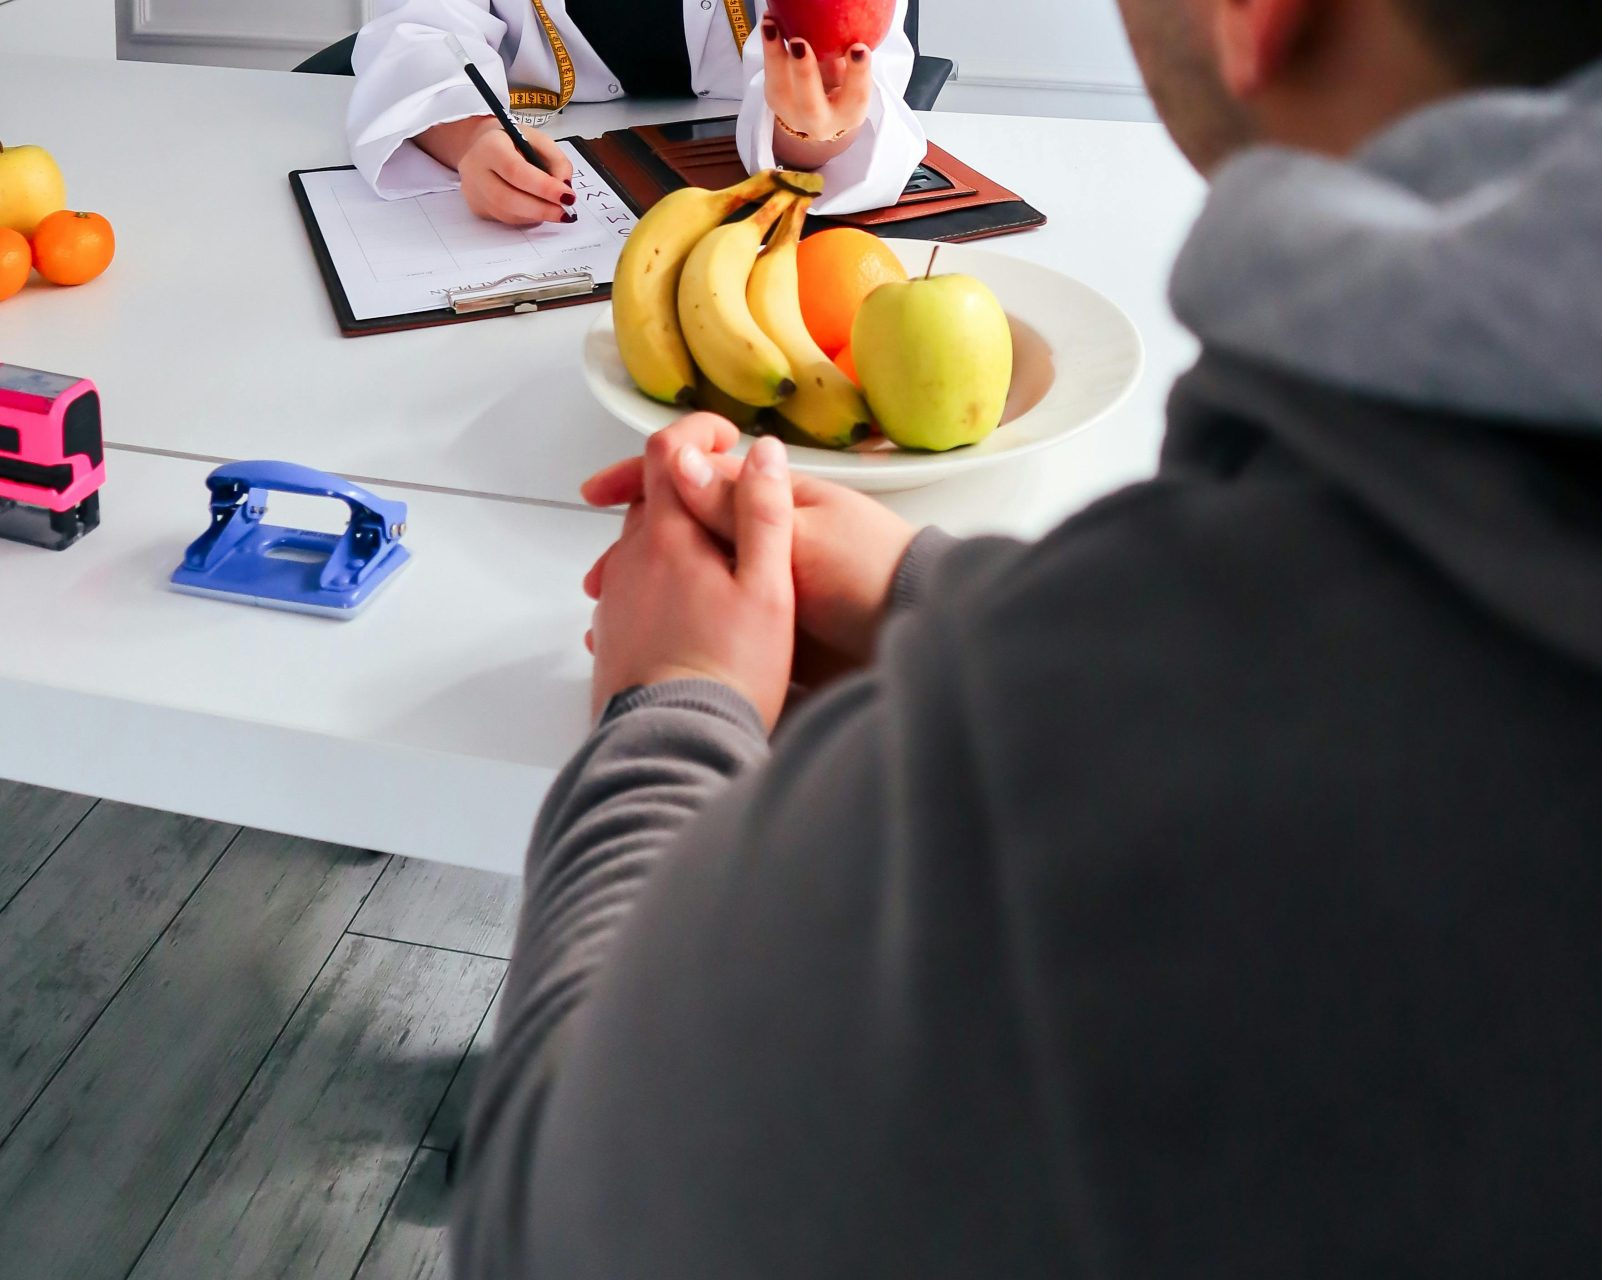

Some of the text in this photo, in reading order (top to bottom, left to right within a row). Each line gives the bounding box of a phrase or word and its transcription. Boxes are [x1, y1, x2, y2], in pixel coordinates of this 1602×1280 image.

[576, 181, 594, 190] T
[586, 191, 609, 201] W
[599, 203, 615, 211] T
[606, 213, 630, 224] M
